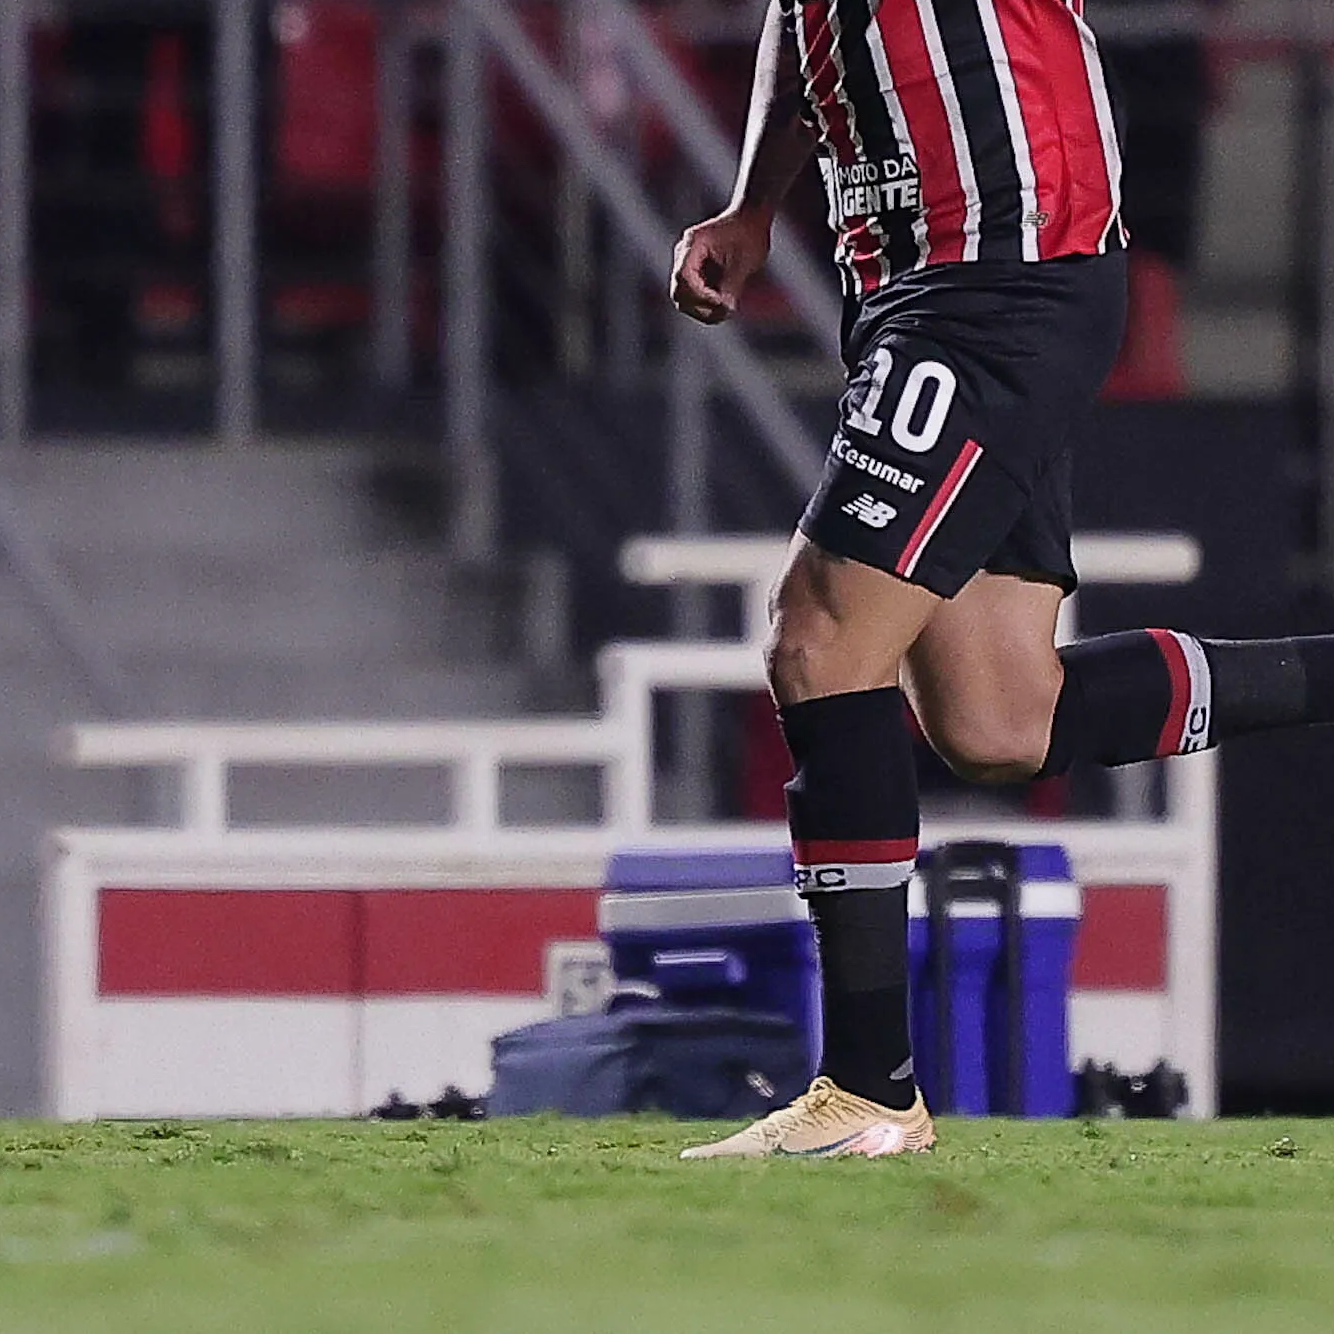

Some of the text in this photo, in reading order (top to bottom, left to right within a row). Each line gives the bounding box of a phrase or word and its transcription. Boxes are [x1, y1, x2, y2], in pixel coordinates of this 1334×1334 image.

[883, 155, 918, 179] DA
[842, 177, 919, 217] GENTE
[845, 347, 957, 453] 10
